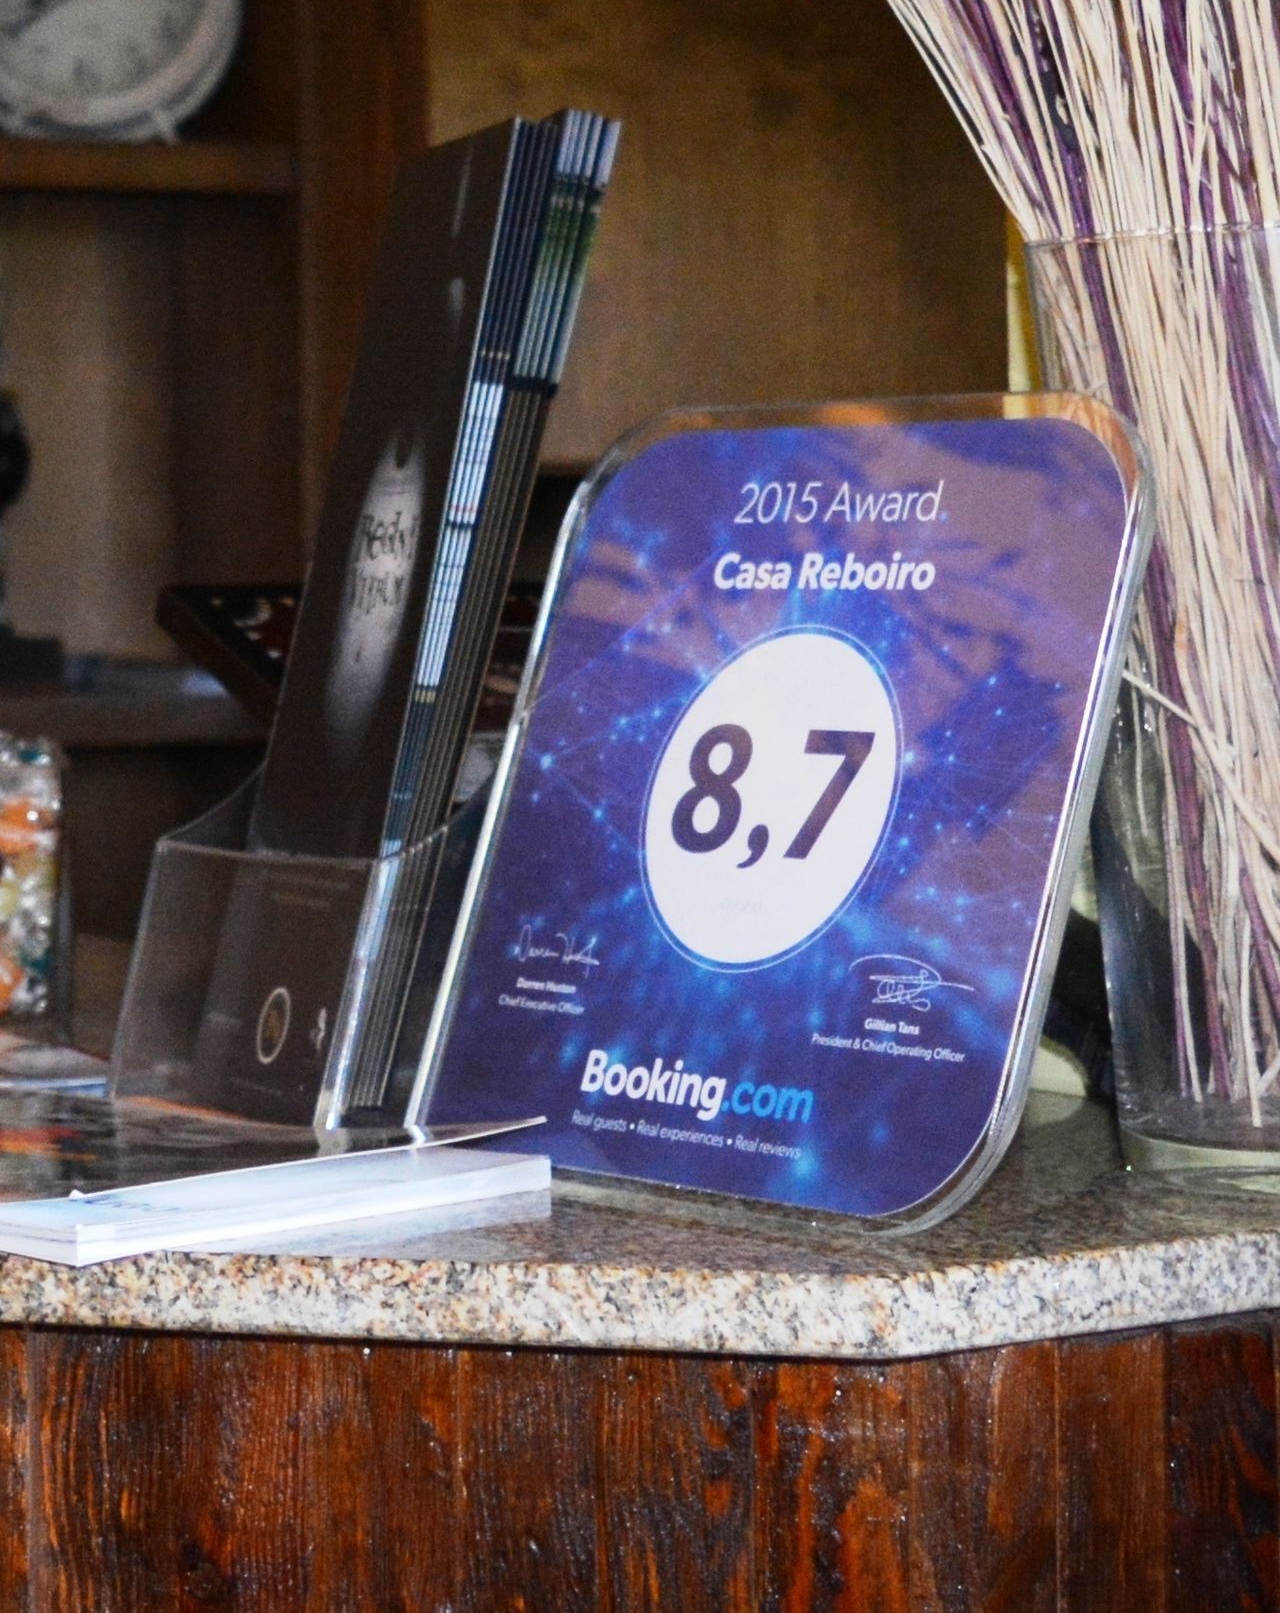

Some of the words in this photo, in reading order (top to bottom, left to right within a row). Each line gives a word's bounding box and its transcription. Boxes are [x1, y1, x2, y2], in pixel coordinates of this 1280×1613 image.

[734, 481, 823, 524] 2015
[824, 479, 945, 523] Award
[713, 551, 793, 591] Casa
[797, 550, 937, 591] Reboiro
[671, 723, 876, 870] 8,7
[811, 1032, 853, 1049] President
[852, 1039, 861, 1050] &
[861, 1039, 886, 1052] Chief
[886, 1042, 932, 1061] Operating
[933, 1047, 965, 1063] Officer
[864, 1017, 896, 1033] Gillian
[898, 1021, 920, 1036] Tans
[580, 1049, 815, 1123] Booking.com
[571, 1109, 592, 1125] Real
[592, 1114, 628, 1132] guests
[637, 1119, 659, 1137] Real
[659, 1127, 724, 1148] experiences
[735, 1134, 758, 1153] Real
[758, 1141, 802, 1160] reviews
